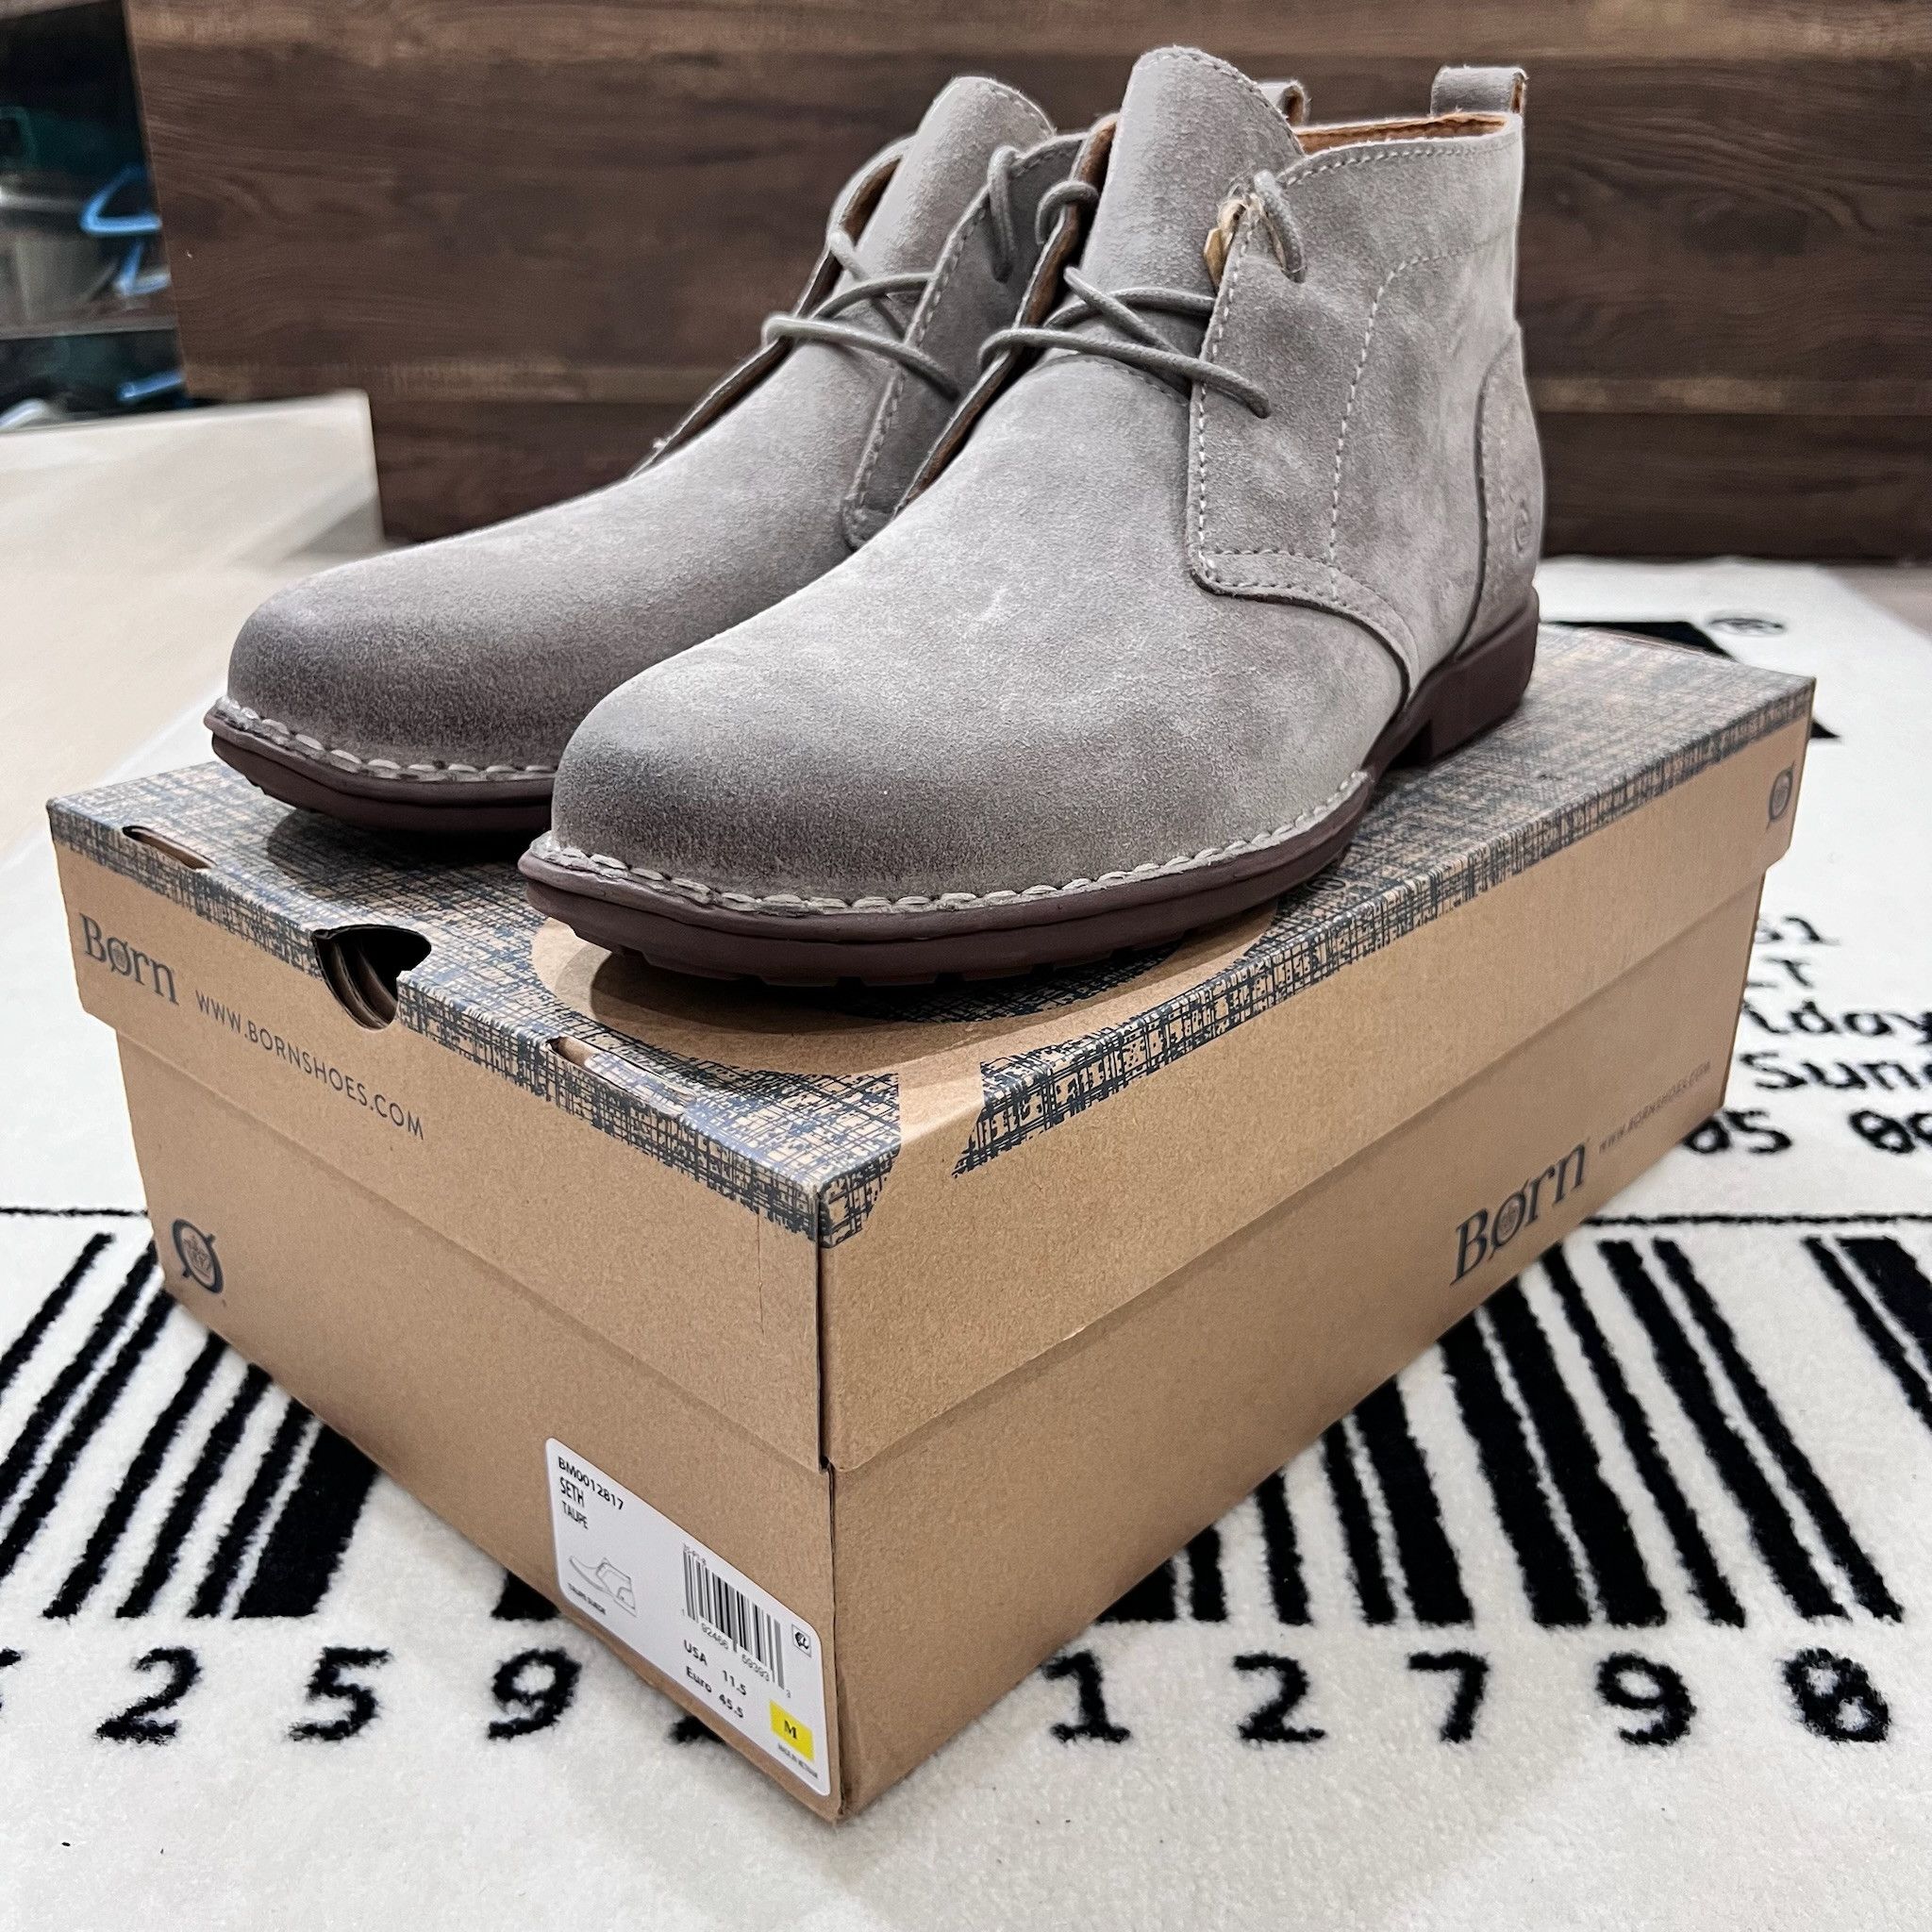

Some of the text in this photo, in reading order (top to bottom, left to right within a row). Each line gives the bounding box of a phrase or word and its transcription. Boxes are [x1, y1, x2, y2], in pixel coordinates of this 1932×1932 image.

[195, 989, 424, 1141] WWW.BORNSHOES.COM
[1740, 1052, 1932, 1091] Sun
[558, 1456, 624, 1510] BM0012817
[559, 1476, 585, 1507] SETH
[561, 1500, 589, 1530] TAUPE
[683, 1639, 747, 1696] USA 11.5
[685, 1664, 744, 1719] Euro 45.5
[94, 1646, 203, 1745] 2
[289, 1646, 390, 1742] 5
[487, 1646, 583, 1741] 9
[1041, 1650, 1131, 1745] 1
[1232, 1651, 1326, 1745] 2
[1407, 1649, 1491, 1744] 7
[1594, 1651, 1697, 1748] 9
[783, 1719, 798, 1740] M
